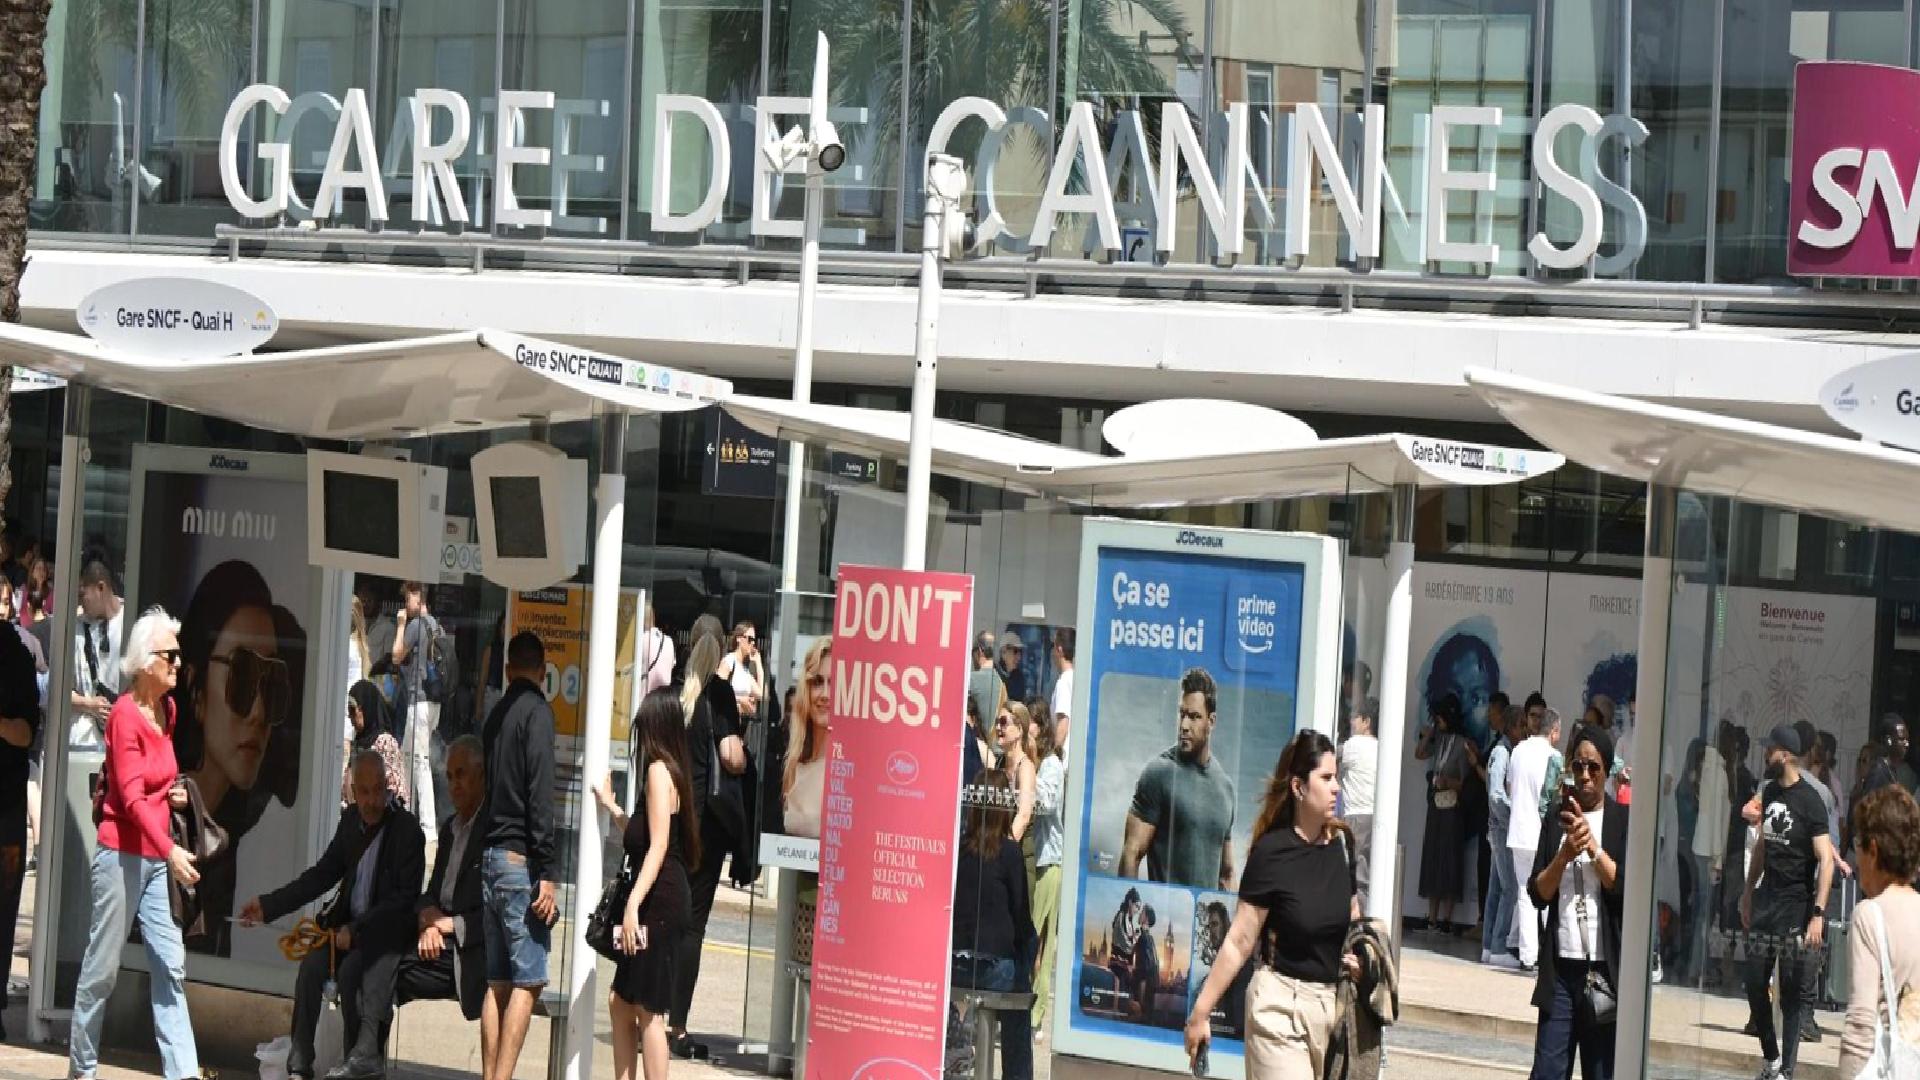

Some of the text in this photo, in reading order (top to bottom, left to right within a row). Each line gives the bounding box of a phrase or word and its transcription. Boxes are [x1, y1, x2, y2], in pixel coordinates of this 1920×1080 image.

[219, 84, 1604, 269] GARE DE CANNES
[117, 308, 145, 328] Gare
[147, 309, 181, 329] SNCF
[192, 311, 219, 331] Quai
[223, 312, 233, 331] H
[515, 344, 622, 383] Gare SNCF QUAI H
[1412, 440, 1433, 462] Gare
[1435, 443, 1461, 466] SNCF
[1175, 530, 1224, 548] JCDecaux
[1112, 571, 1171, 610] Ça se
[839, 581, 963, 648] DON'T
[1238, 594, 1277, 617] prime
[1760, 602, 1826, 623] Bienvenue
[1110, 616, 1205, 653] passe ici
[1238, 616, 1275, 637] video
[565, 674, 578, 696] 2
[834, 659, 944, 729] MISS!
[830, 762, 854, 778] FESTI
[830, 778, 845, 794] VAL
[827, 796, 853, 813] INTER
[827, 813, 852, 830] NATIO
[825, 830, 842, 847] NAL
[875, 831, 946, 856] THE FESTIVAL'S
[825, 847, 838, 863] DU
[873, 850, 917, 869] OFFICIAL
[824, 865, 845, 882] FILM
[872, 868, 925, 889] SELECTION
[823, 883, 835, 898] DE
[872, 886, 908, 904] RERUNS
[822, 899, 840, 917] CAN
[820, 916, 838, 934] NES
